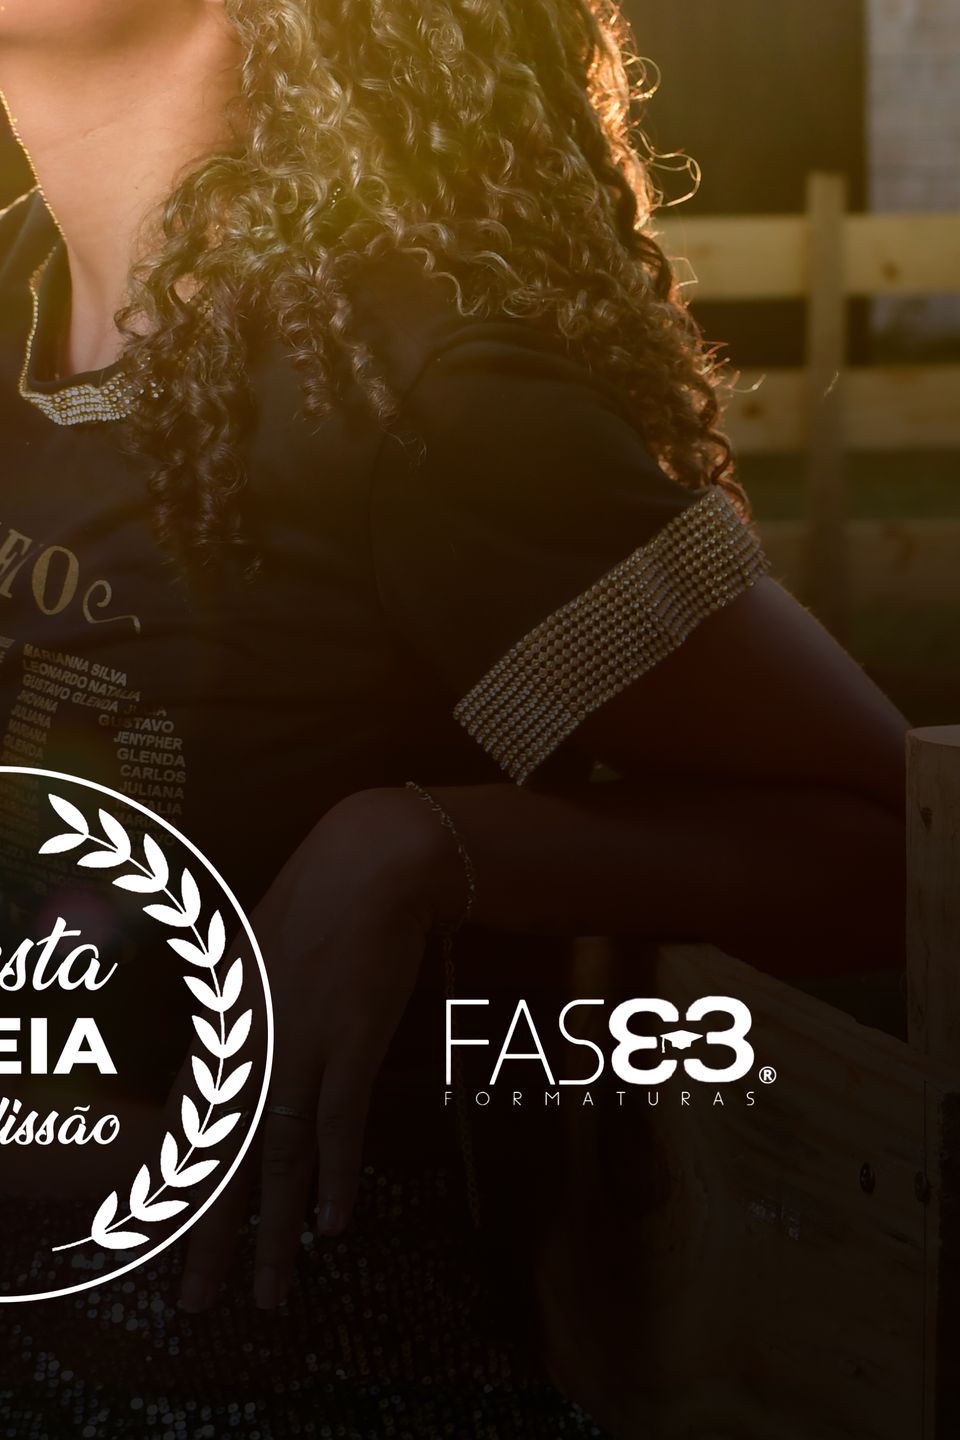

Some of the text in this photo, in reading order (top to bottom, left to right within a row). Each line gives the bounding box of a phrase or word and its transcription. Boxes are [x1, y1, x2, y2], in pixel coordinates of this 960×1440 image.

[23, 659, 141, 702] LEONARDO NATALIA
[91, 663, 128, 687] SILVA
[23, 674, 119, 713] GUSTAVO GLENDA
[98, 714, 175, 734] GUSTAVO
[113, 731, 183, 751] JENYPHER
[116, 747, 186, 768] GLENDA
[120, 764, 187, 784] CARLOS
[119, 781, 185, 800] JULIANA
